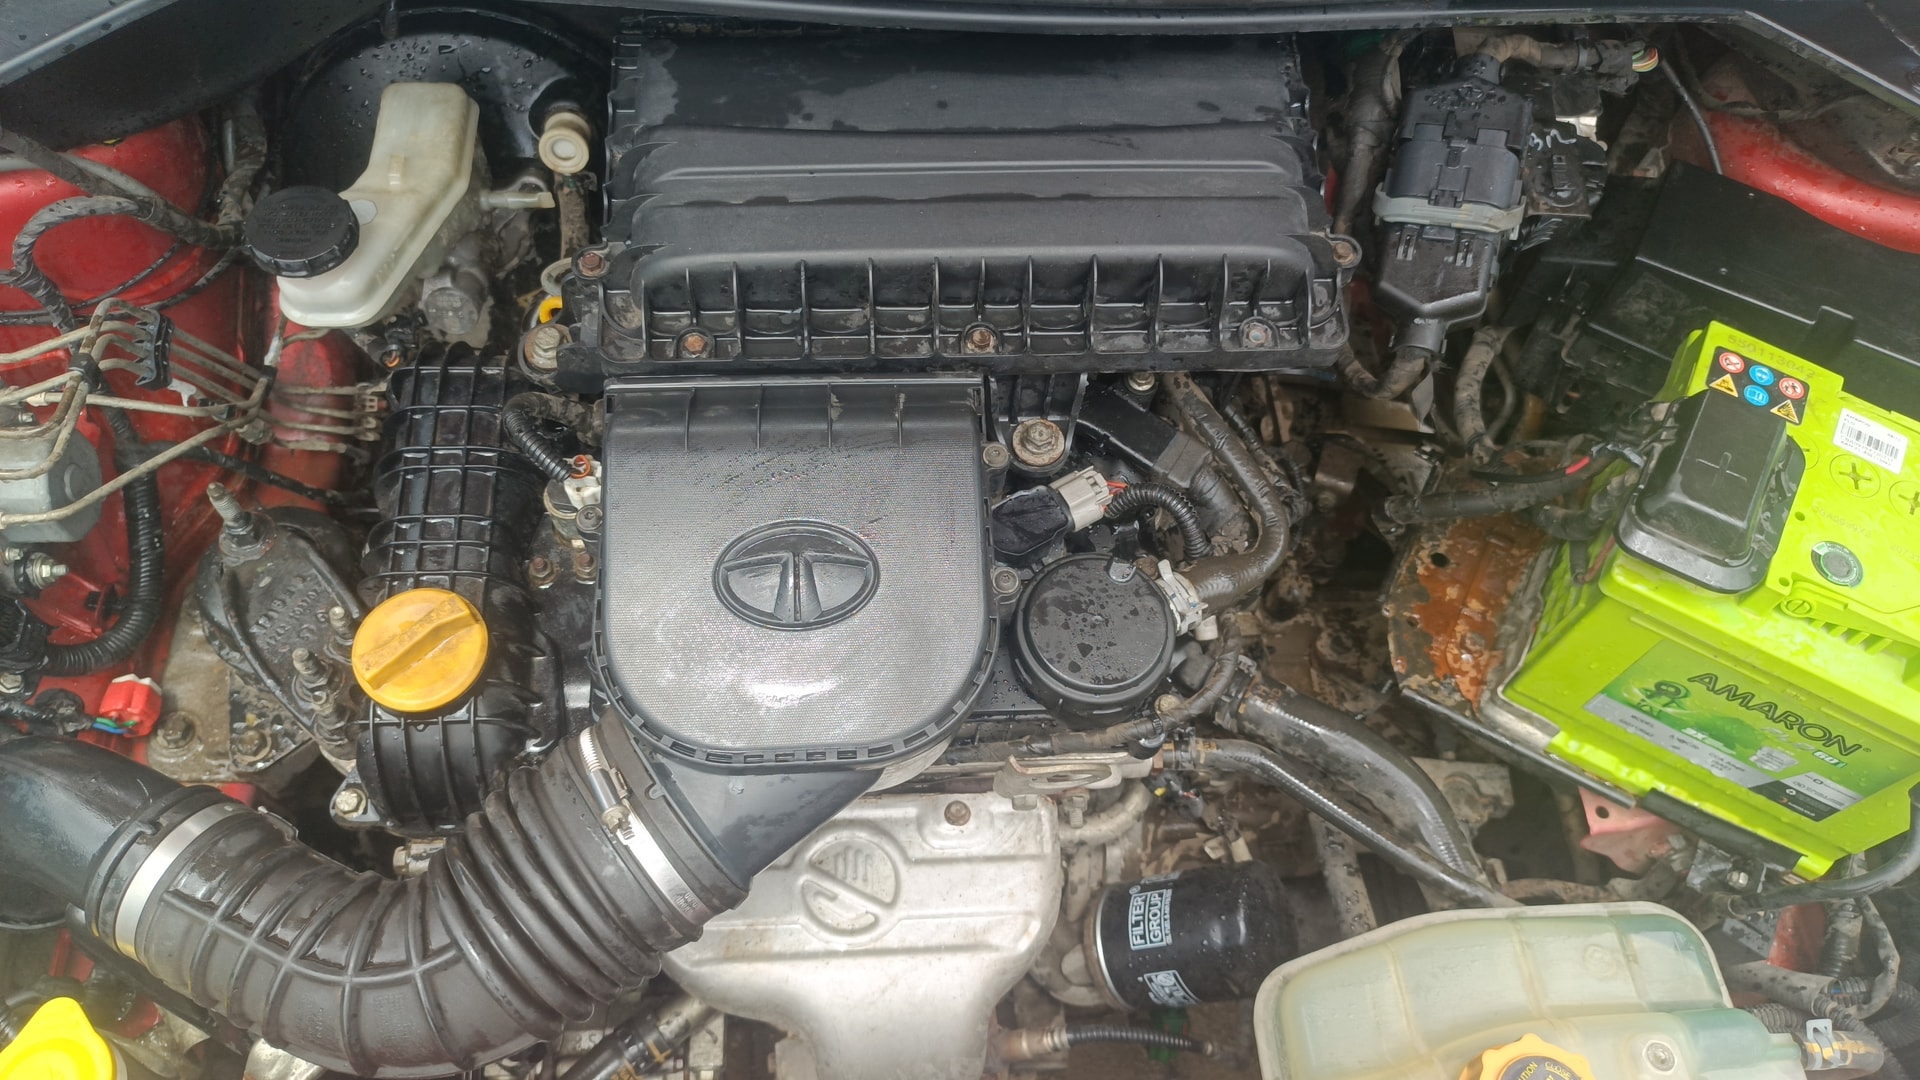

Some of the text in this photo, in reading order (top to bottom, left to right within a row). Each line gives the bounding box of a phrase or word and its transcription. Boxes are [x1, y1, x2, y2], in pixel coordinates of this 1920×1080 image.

[1687, 672, 1863, 756] AMARON
[1132, 895, 1146, 945] FILTER
[1149, 893, 1162, 942] GROUP
